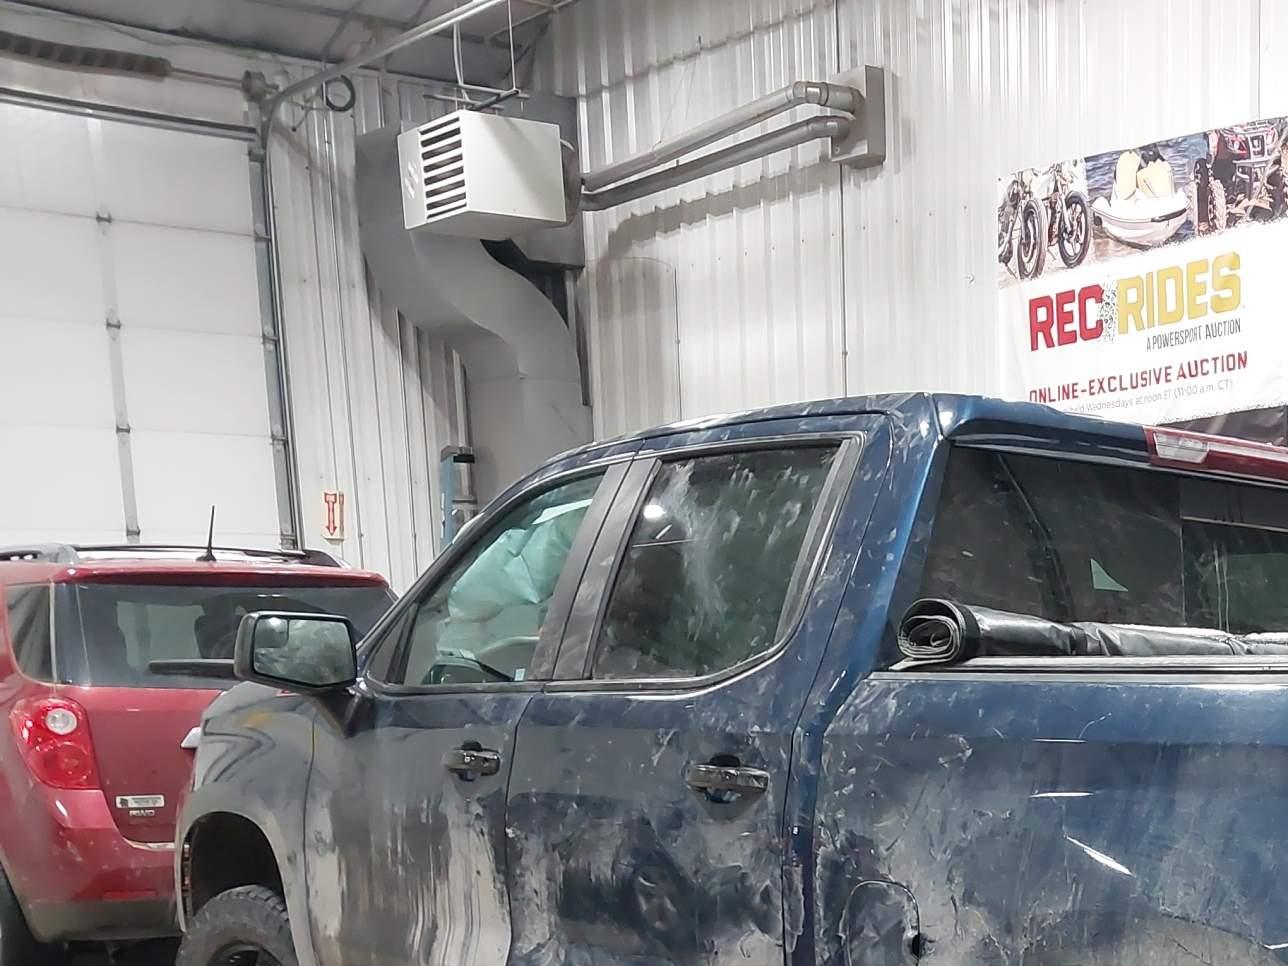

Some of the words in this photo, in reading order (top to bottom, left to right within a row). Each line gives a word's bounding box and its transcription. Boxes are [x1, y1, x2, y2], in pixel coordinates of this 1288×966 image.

[1029, 284, 1104, 352] REC
[1117, 251, 1242, 335] RIDES
[1146, 337, 1151, 352] A
[1152, 326, 1201, 350] POWERSPORT
[1205, 318, 1241, 339] AUCTION
[1029, 366, 1173, 404] ONLINE-EXCLUSIVE
[1177, 351, 1248, 379] AUCTION
